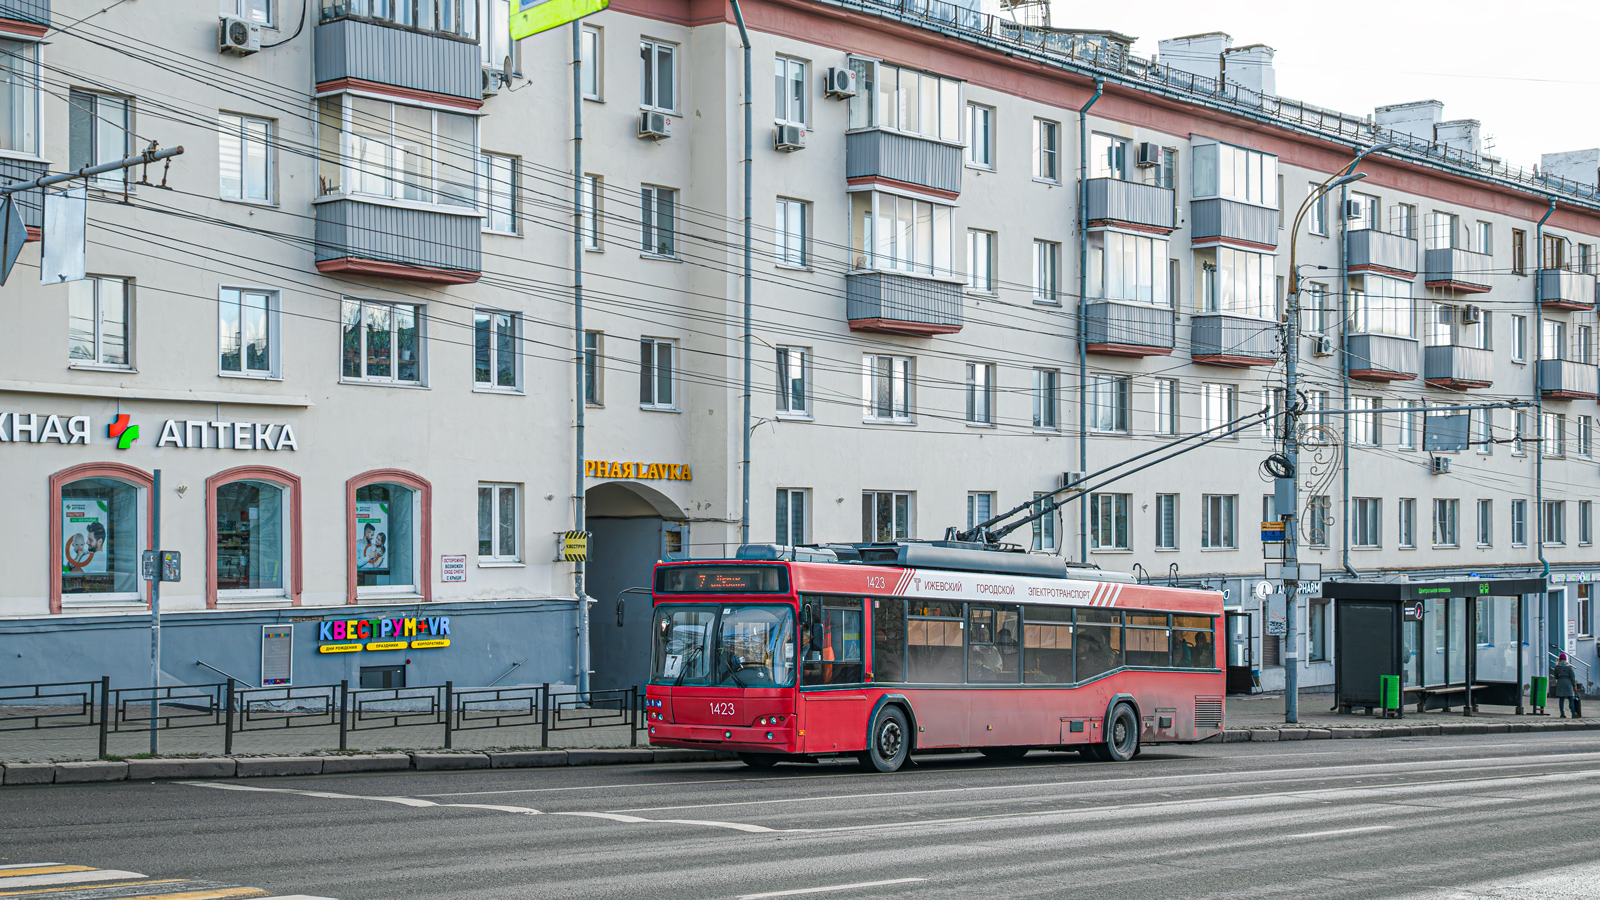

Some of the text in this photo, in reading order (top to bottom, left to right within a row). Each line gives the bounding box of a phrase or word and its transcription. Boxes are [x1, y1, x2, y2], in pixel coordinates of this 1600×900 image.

[157, 420, 299, 451] АПТЕКА
[636, 462, 692, 480] LAVKA
[699, 575, 706, 587] 7
[866, 576, 1090, 599] 1423 ИЖЕВСКИЙ ГОРОДСКОЙ ЭЛЕКТРОТРАНСПОРТ
[671, 656, 678, 670] 7
[710, 702, 735, 715] 1423
